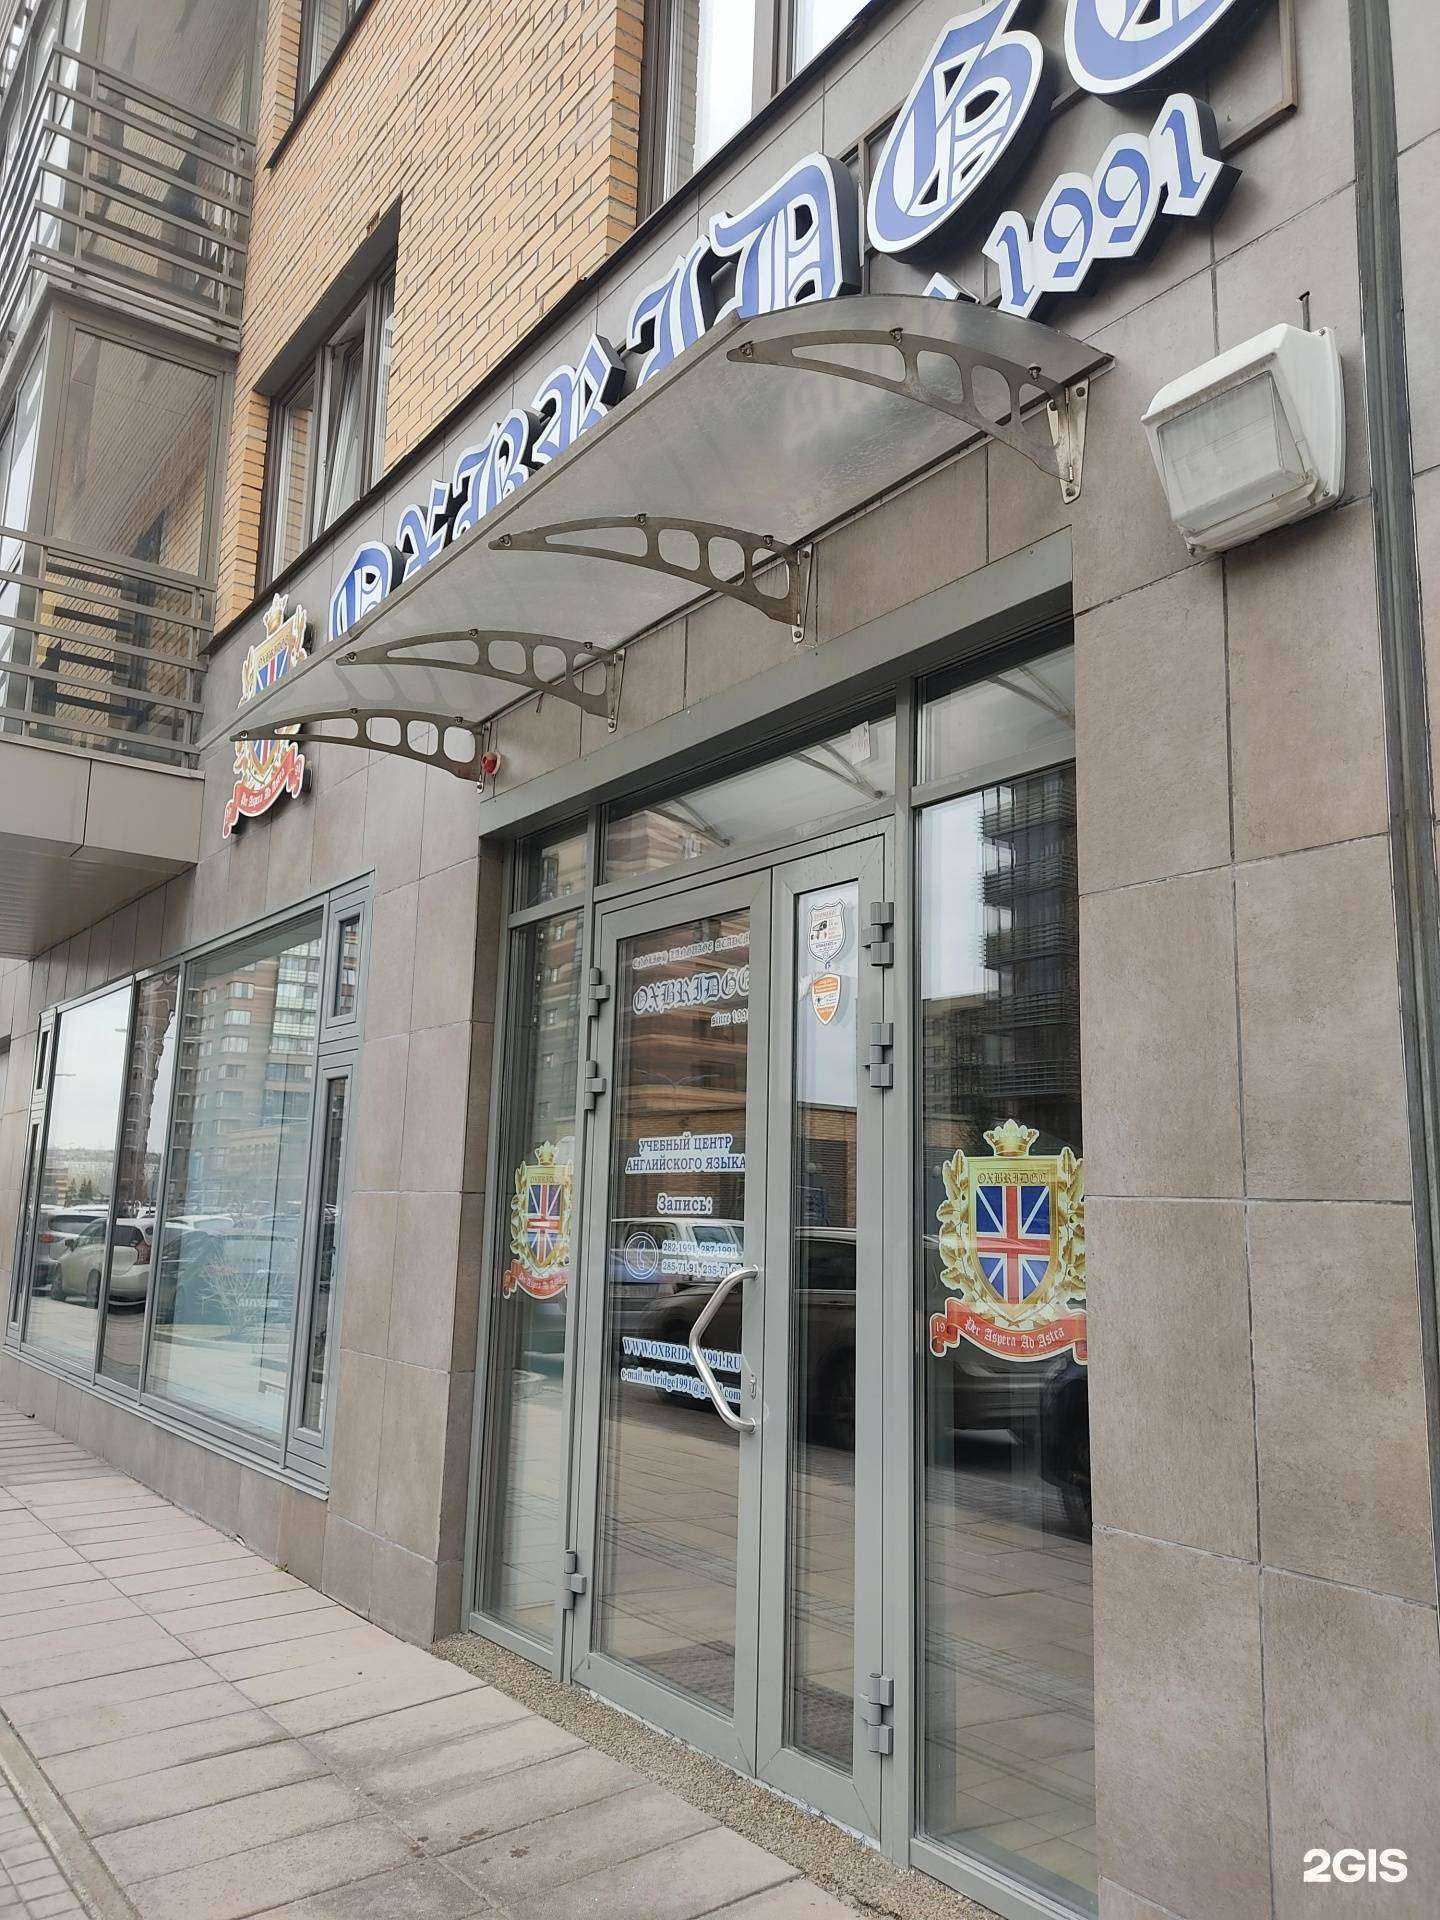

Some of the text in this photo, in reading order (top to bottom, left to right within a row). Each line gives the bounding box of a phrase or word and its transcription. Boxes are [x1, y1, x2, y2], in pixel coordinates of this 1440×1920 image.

[984, 94, 1221, 317] 1991
[640, 1133, 732, 1152] УЧЕБНЫЙ ЦЕНТР
[626, 1155, 745, 1172] АНГЛИЙСКОГО ЯЗЫКА
[658, 1195, 712, 1212] Запись:
[964, 1316, 1065, 1349] Per Aspera Ad Astra
